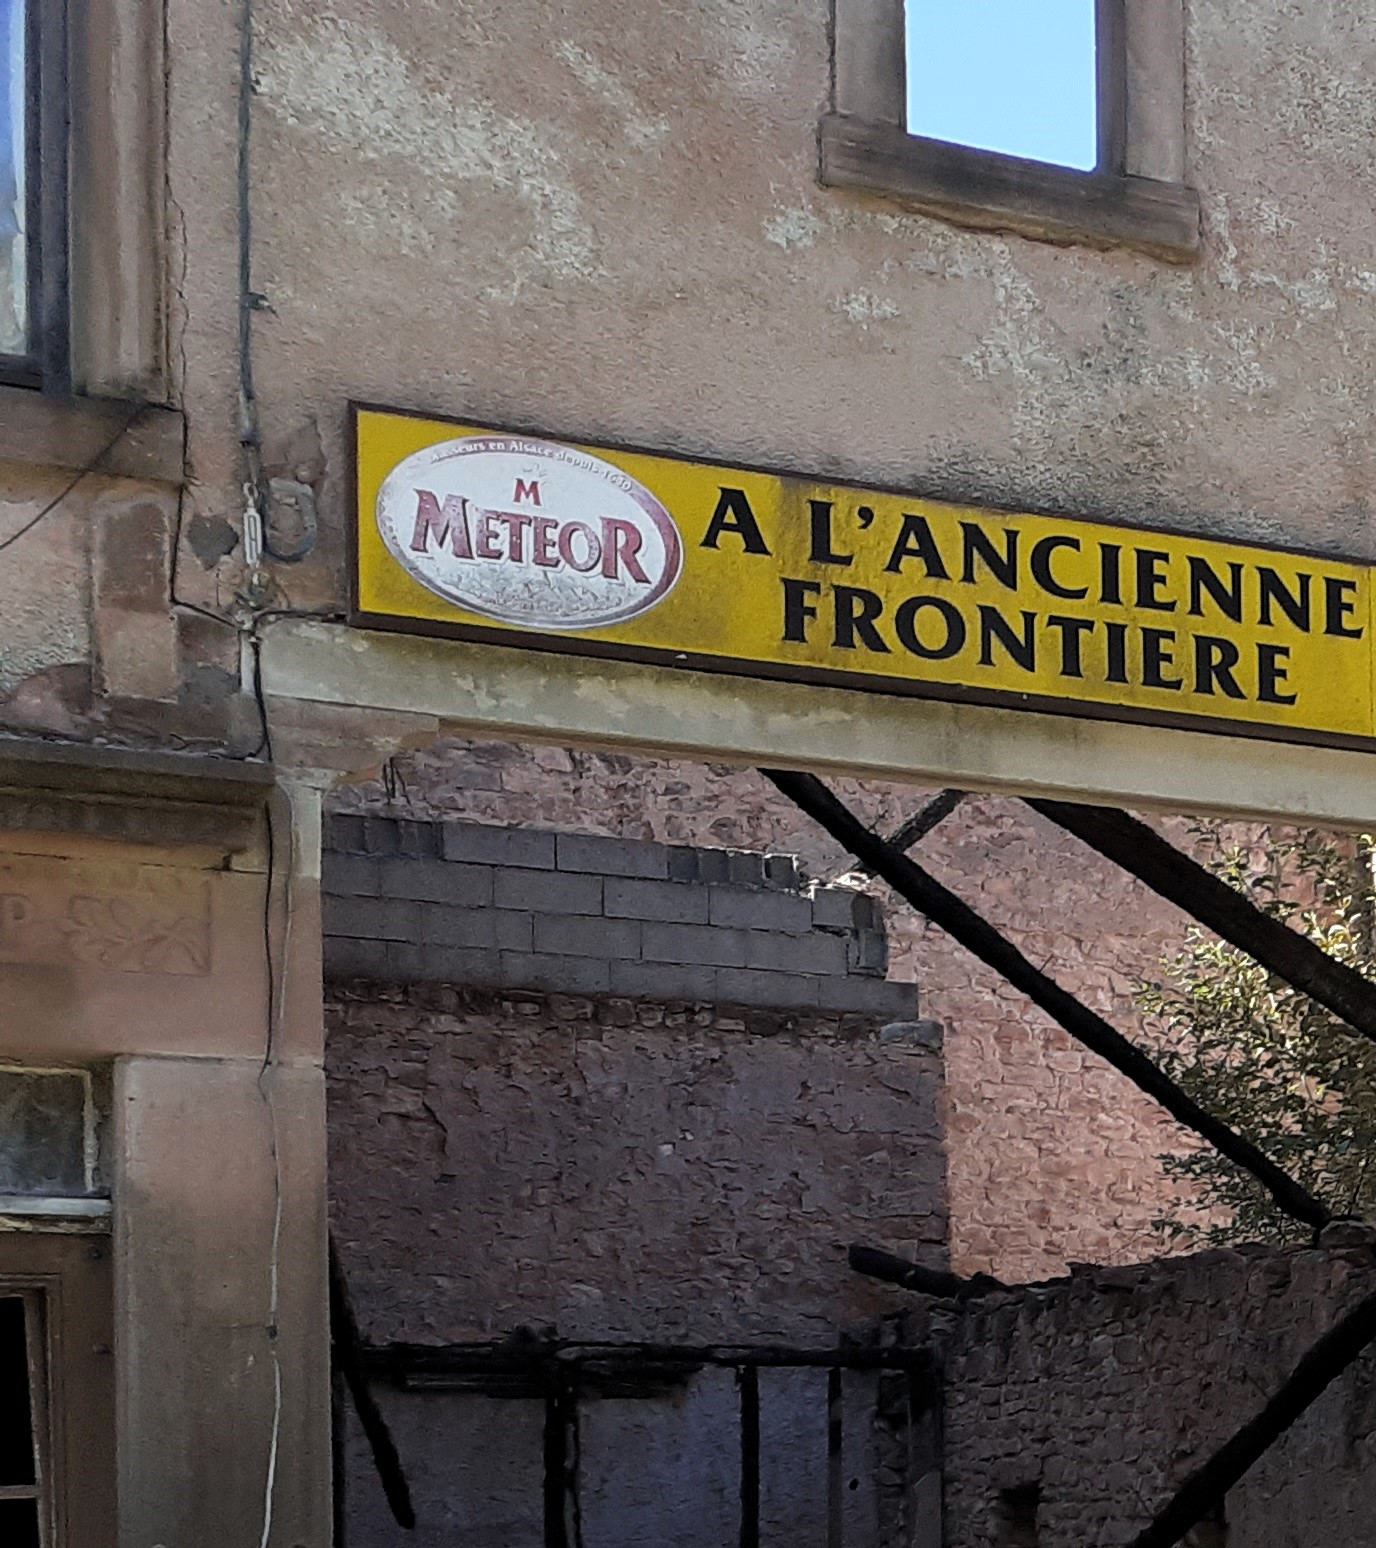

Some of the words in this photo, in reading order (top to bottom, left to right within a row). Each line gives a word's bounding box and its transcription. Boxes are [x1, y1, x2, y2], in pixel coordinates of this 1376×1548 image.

[488, 441, 505, 451] en
[509, 440, 553, 456] Alsace
[557, 451, 599, 474] depuis
[513, 477, 542, 506] M
[409, 488, 652, 584] METEOR
[700, 486, 773, 557] A
[807, 499, 1365, 640] L'ANCIENNE
[780, 577, 1298, 706] FRONTIERE
